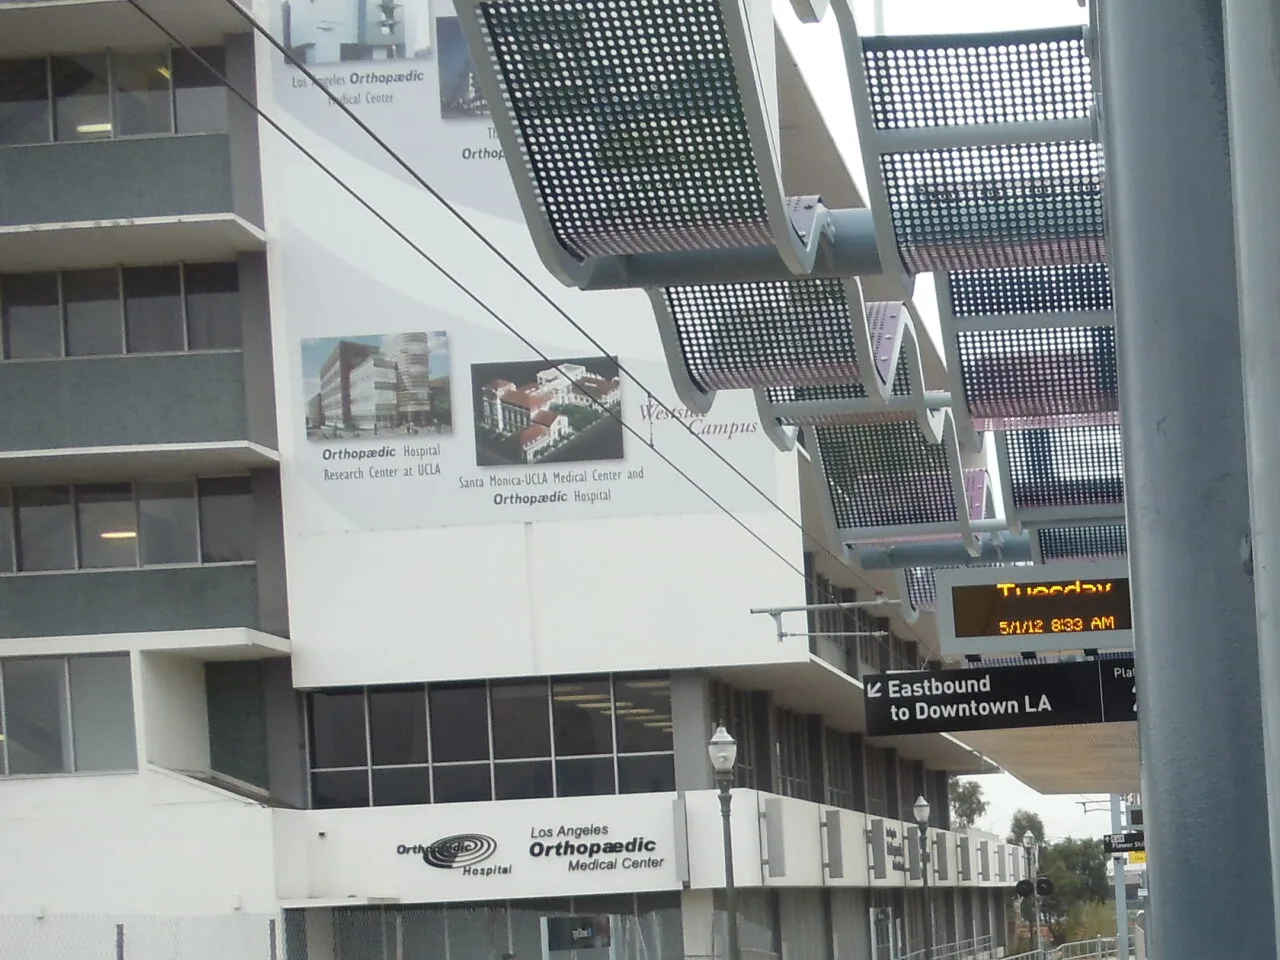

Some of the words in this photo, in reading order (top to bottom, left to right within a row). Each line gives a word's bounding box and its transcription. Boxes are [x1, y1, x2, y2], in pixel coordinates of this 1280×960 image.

[292, 75, 307, 88] Los
[365, 91, 393, 105] Center
[689, 418, 758, 439] Campus
[403, 444, 441, 460] Hospital
[324, 467, 364, 481] Research
[369, 466, 398, 479] Center
[403, 467, 413, 477] at
[418, 463, 441, 476] UCLA
[459, 475, 484, 489] Santa
[489, 472, 548, 487] Monica-UCLA
[553, 469, 587, 484] Medical
[592, 468, 622, 482] Center
[627, 466, 644, 479] and
[574, 488, 611, 504] Hospital
[999, 619, 1044, 635] 5/1/12
[1051, 617, 1083, 633] 8:33
[1091, 615, 1115, 631] AM
[888, 674, 991, 699] Eastbound
[890, 704, 910, 722] to
[915, 698, 1019, 720] Downtown
[1025, 694, 1052, 713] LA
[530, 827, 553, 839] Los
[557, 824, 608, 839] Angeles
[463, 864, 512, 877] Hospital
[568, 858, 617, 872] Medical
[621, 857, 664, 870] Center
